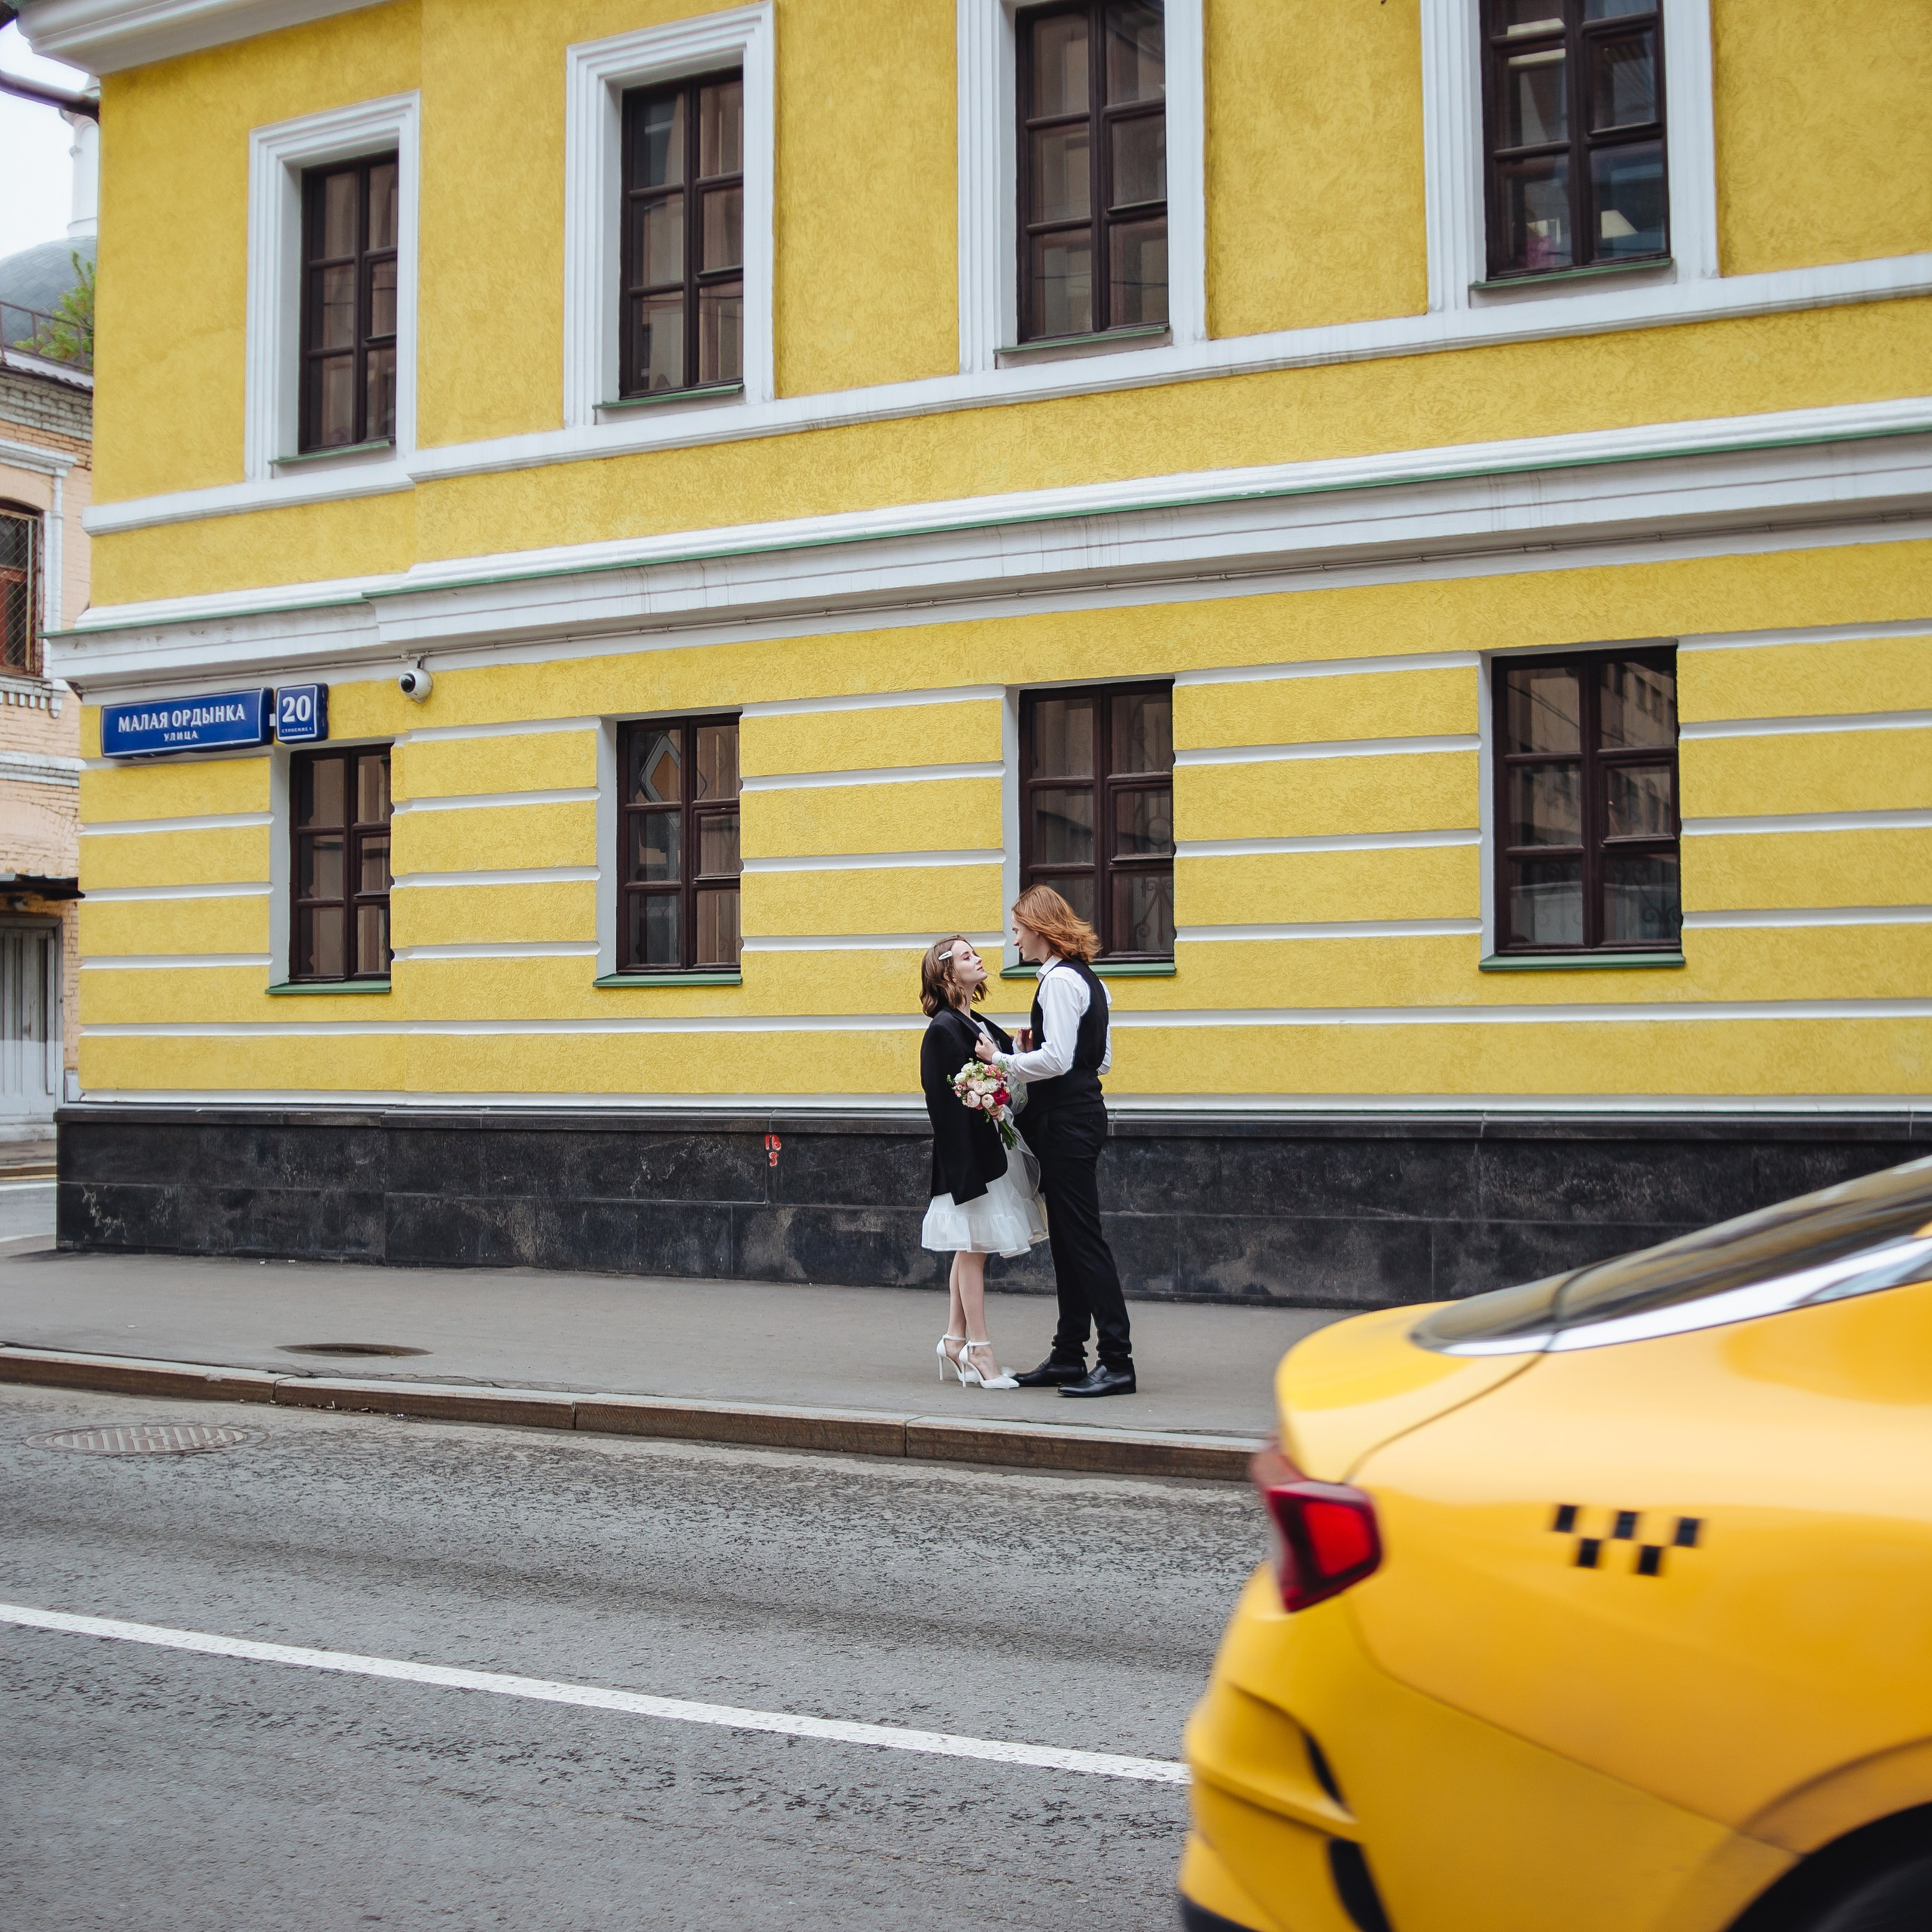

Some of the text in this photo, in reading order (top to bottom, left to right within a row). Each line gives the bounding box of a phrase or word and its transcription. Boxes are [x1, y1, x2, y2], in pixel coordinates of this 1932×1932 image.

[118, 703, 246, 733] МАЛАЯ ОРДЫНКА
[282, 695, 311, 722] 20
[164, 731, 198, 742] УЛИЦА
